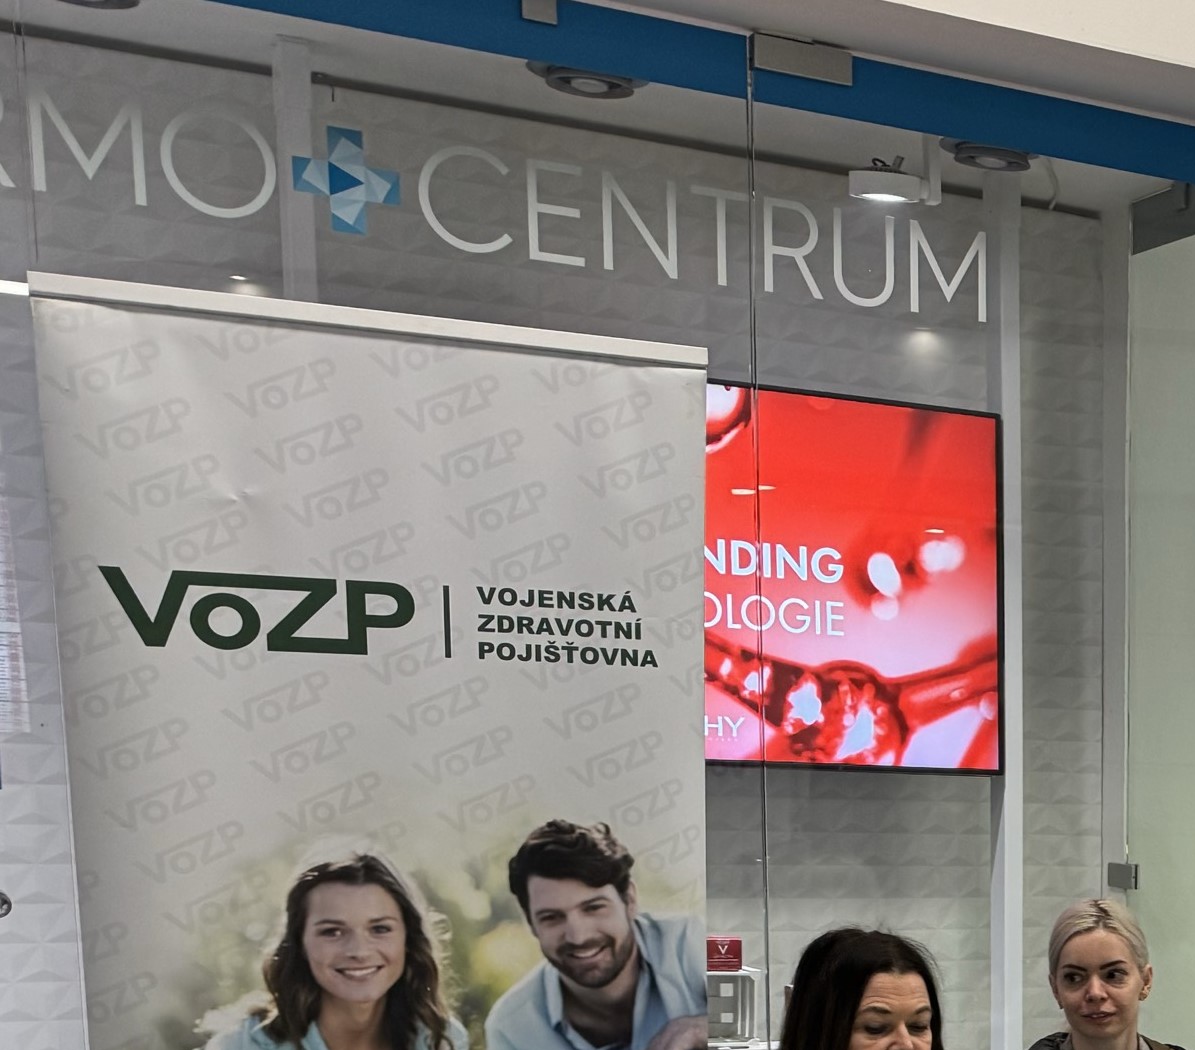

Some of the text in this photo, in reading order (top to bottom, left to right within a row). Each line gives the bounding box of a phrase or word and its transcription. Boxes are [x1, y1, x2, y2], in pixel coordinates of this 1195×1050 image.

[418, 145, 987, 323] CENTRUM
[98, 565, 415, 655] VoZP
[476, 586, 637, 613] VOJENSKÁ
[477, 614, 643, 640] ZDRAVOTNÍ
[478, 641, 659, 668] POJIŠŤOVNA
